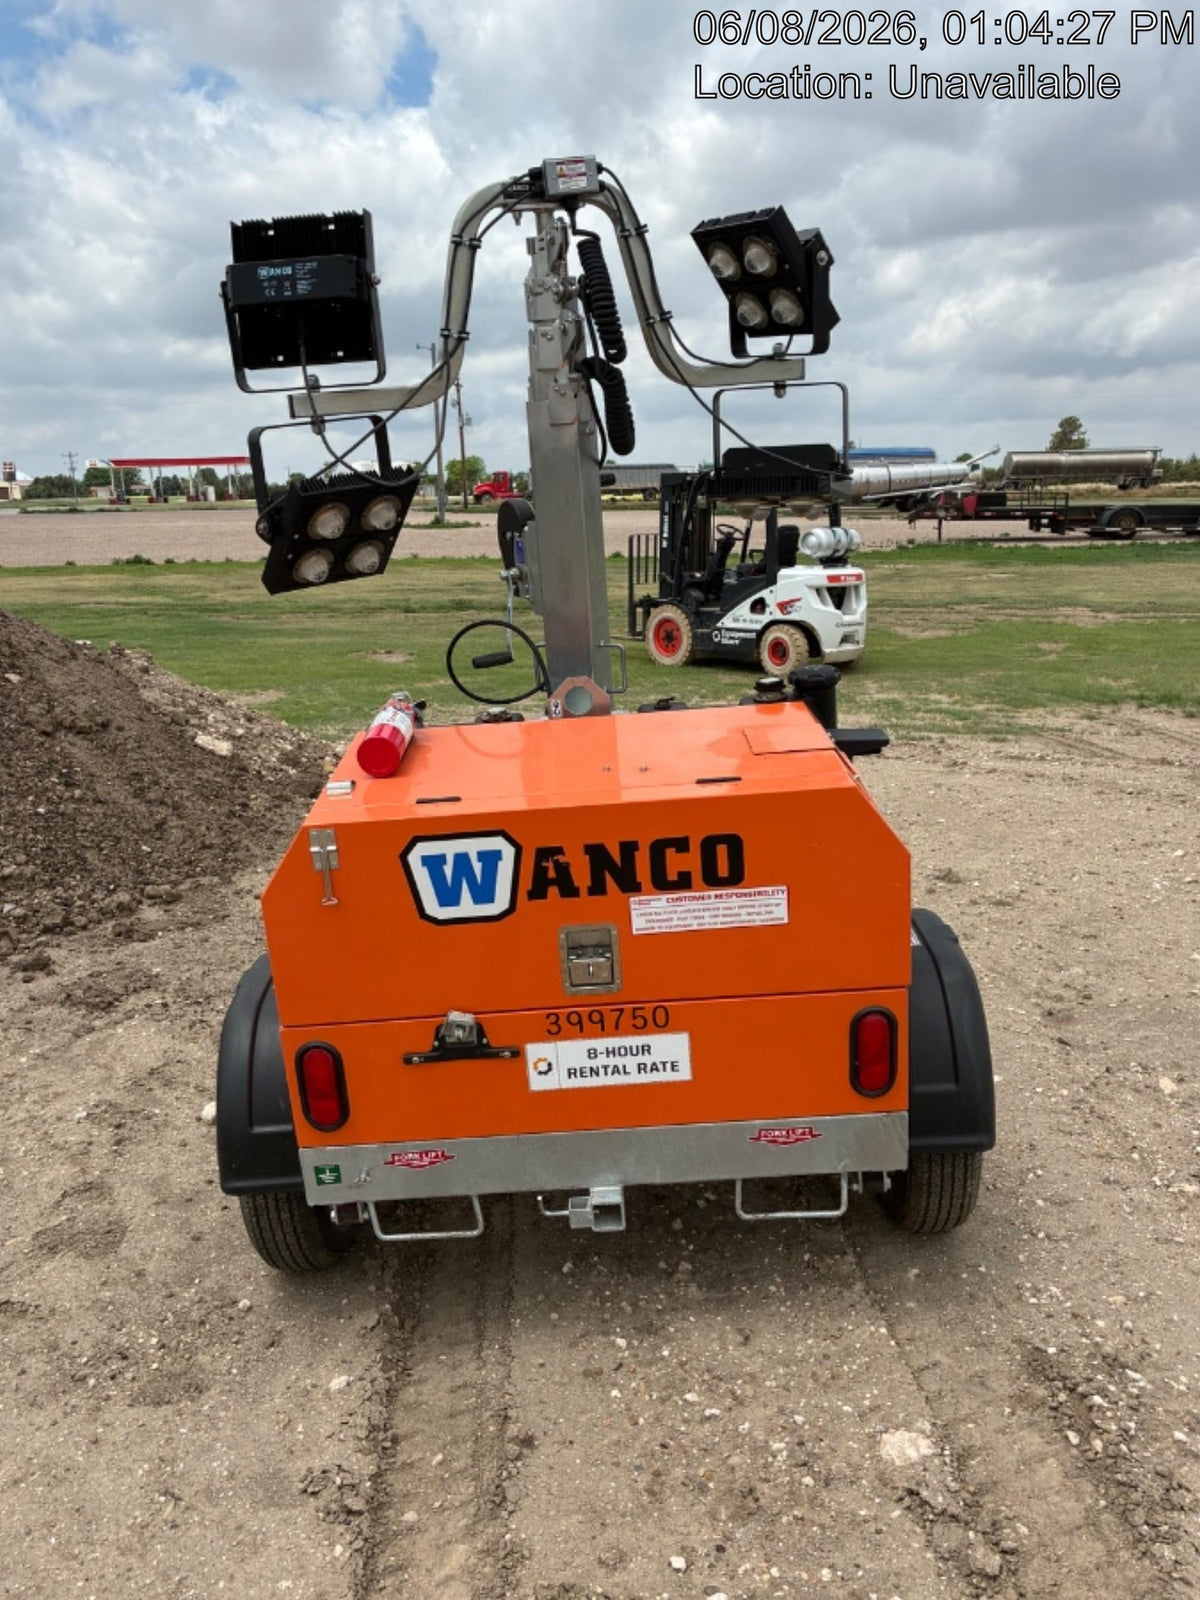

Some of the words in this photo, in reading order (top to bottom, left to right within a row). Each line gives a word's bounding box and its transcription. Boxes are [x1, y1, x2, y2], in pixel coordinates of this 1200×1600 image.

[416, 832, 746, 910] WANCO
[666, 893, 712, 904] CUSTOMER
[714, 889, 786, 900] RESPONSIBILITY
[545, 1005, 670, 1036] 399750
[586, 1043, 652, 1060] 8-HOUR
[567, 1064, 632, 1080] RENTAL
[637, 1060, 681, 1075] RATE
[760, 1129, 788, 1138] FORK
[789, 1128, 811, 1136] LIFT
[394, 1152, 422, 1162] FORK
[423, 1150, 443, 1160] LIFT
